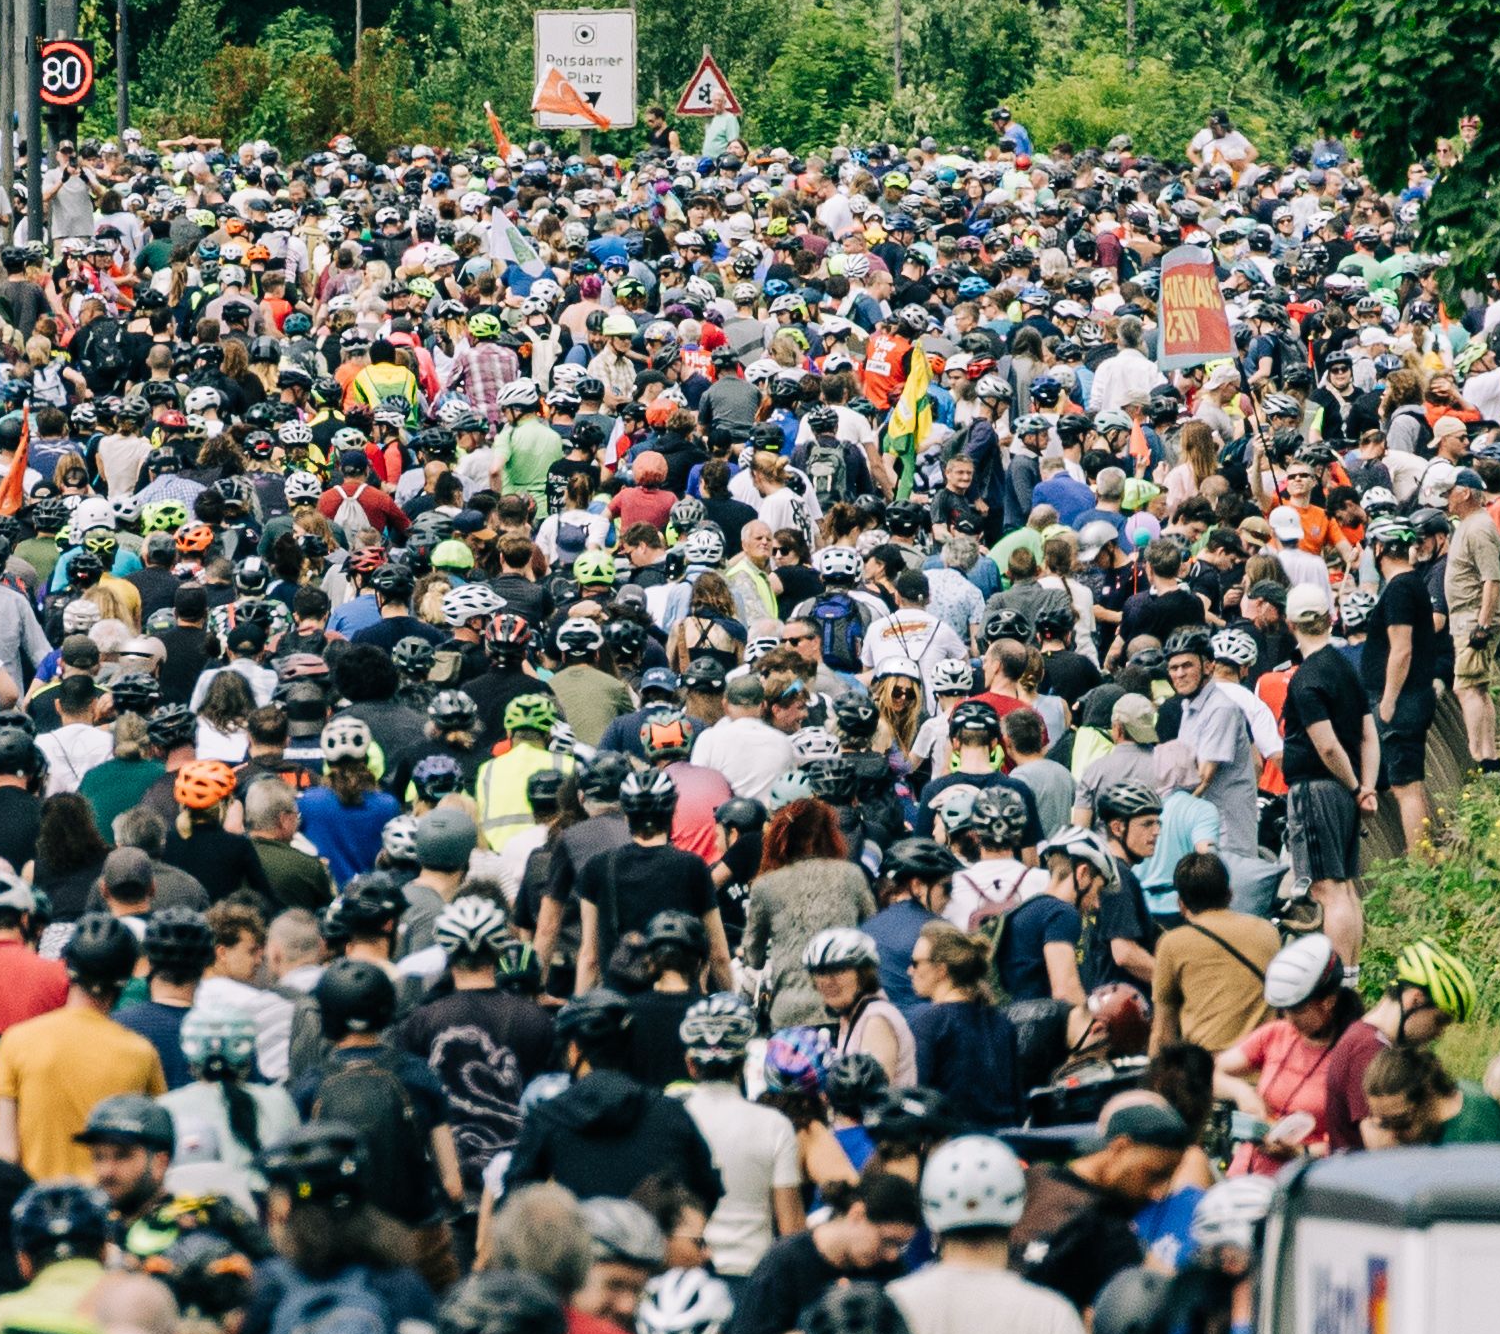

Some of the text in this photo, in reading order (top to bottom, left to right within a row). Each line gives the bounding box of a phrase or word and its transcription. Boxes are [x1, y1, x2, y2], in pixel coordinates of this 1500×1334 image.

[546, 54, 623, 67] Potsdamer
[42, 56, 81, 92] 80
[567, 71, 602, 85] Platz
